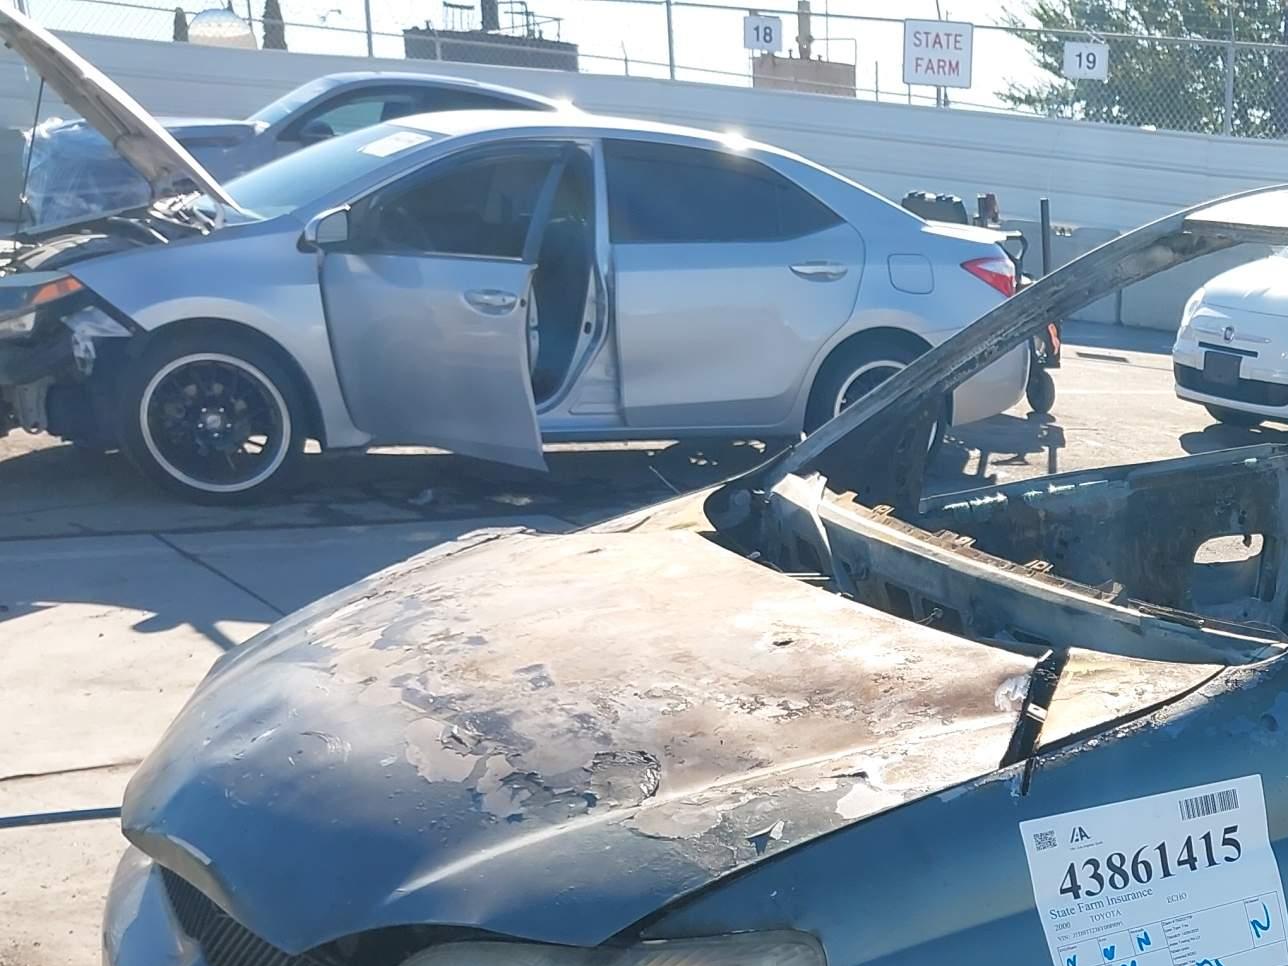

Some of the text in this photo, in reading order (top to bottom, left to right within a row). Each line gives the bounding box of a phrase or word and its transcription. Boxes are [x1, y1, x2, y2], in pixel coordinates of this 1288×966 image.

[752, 25, 773, 44] 18
[912, 31, 963, 50] STATE
[914, 57, 960, 76] FARM
[1075, 52, 1097, 71] 19
[1059, 824, 1242, 900] 43861415
[1049, 888, 1153, 920] State Farm Insurance
[1090, 909, 1121, 922] TOYOTA
